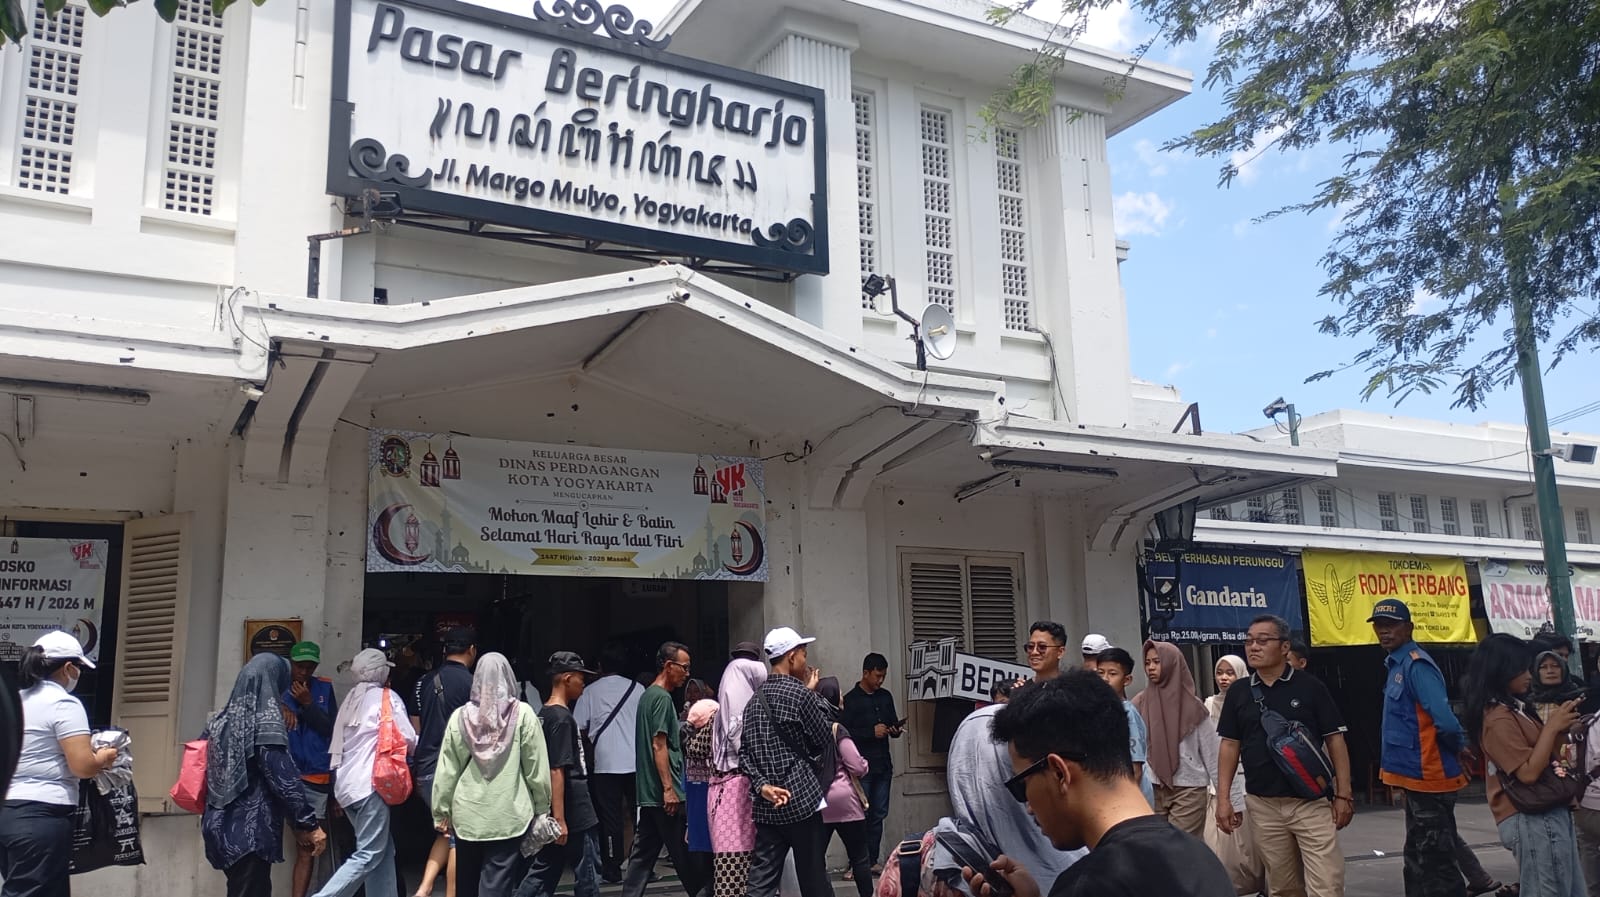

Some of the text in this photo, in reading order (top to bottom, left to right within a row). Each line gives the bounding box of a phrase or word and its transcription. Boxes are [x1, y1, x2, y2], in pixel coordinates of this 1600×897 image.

[367, 5, 807, 149] Pasar Beringharjo
[433, 157, 753, 236] Jl. Margo Mulyo, Yogyakarta
[533, 449, 627, 465] KELUARGA BESAR
[499, 458, 660, 478] DINAS PERDAGANGAN
[508, 473, 654, 493] KOTA YOGYAKARTA
[553, 491, 614, 501] MENGUCAPKAN
[488, 506, 676, 529] Mohon Maaf Lahir & Batin
[480, 526, 685, 550] Selamat Hari Raya Idul Fitri
[1233, 556, 1285, 568] PERUNGGU
[1358, 574, 1467, 597] RODA TERBANG
[25, 596, 35, 609] H
[38, 596, 46, 611] /
[48, 598, 80, 610] 2026
[83, 598, 95, 610] M
[1186, 585, 1268, 608] Gandaria
[1222, 631, 1236, 641] Bisa
